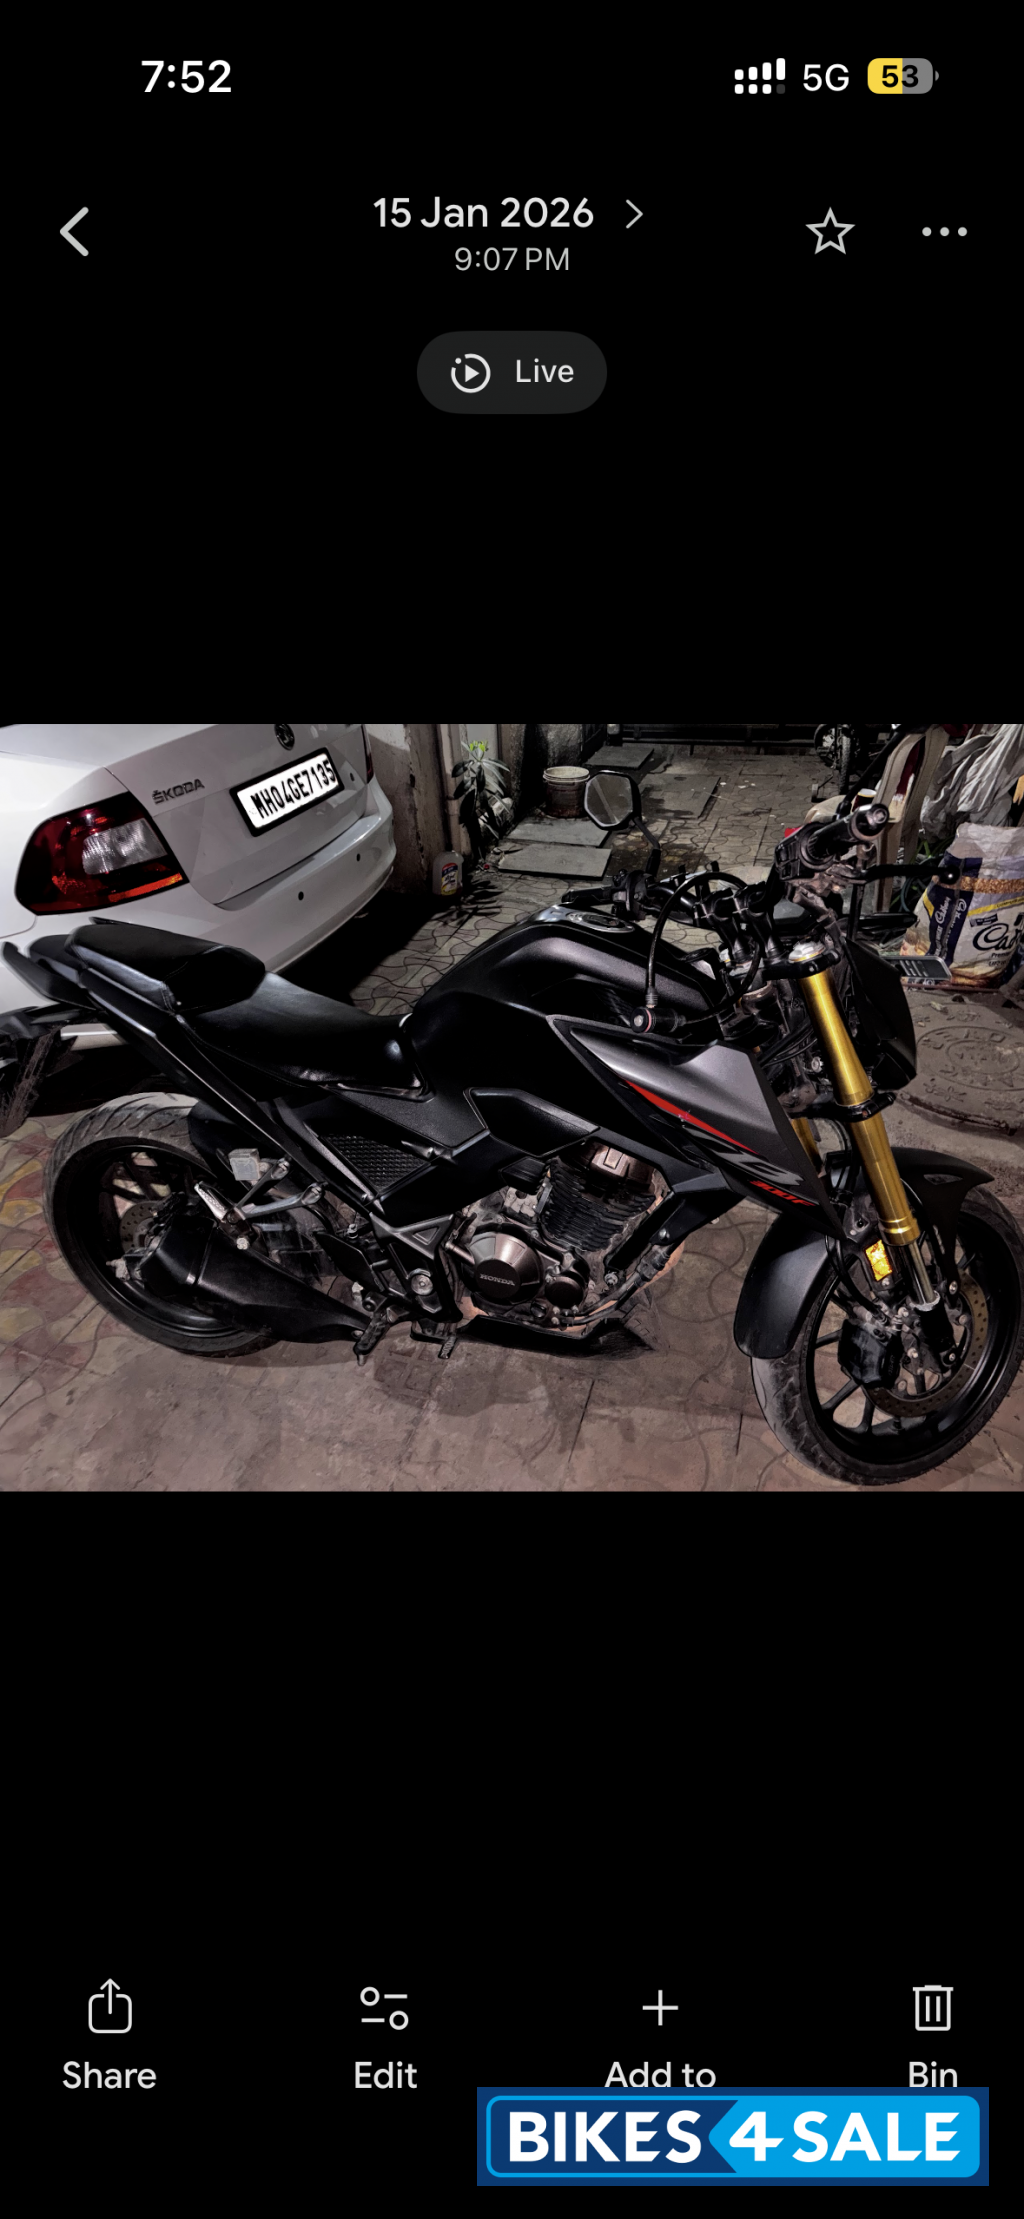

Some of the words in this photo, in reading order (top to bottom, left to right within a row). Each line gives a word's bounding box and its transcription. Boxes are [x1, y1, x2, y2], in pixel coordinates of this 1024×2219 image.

[141, 59, 232, 94] 7:52
[803, 63, 850, 92] 5G
[881, 64, 920, 88] 53
[373, 197, 412, 228] 15
[420, 196, 488, 228] Jan
[500, 196, 594, 228] 2026
[454, 246, 518, 271] 9:07
[525, 247, 569, 271] PM
[516, 357, 574, 383] Live
[250, 759, 336, 819] MH04GE7135
[479, 1273, 516, 1287] HONDA
[62, 2060, 157, 2090] Share
[354, 2060, 418, 2090] Edit
[604, 2061, 672, 2087] Add
[681, 2063, 717, 2087] to
[909, 2060, 958, 2087] Bin
